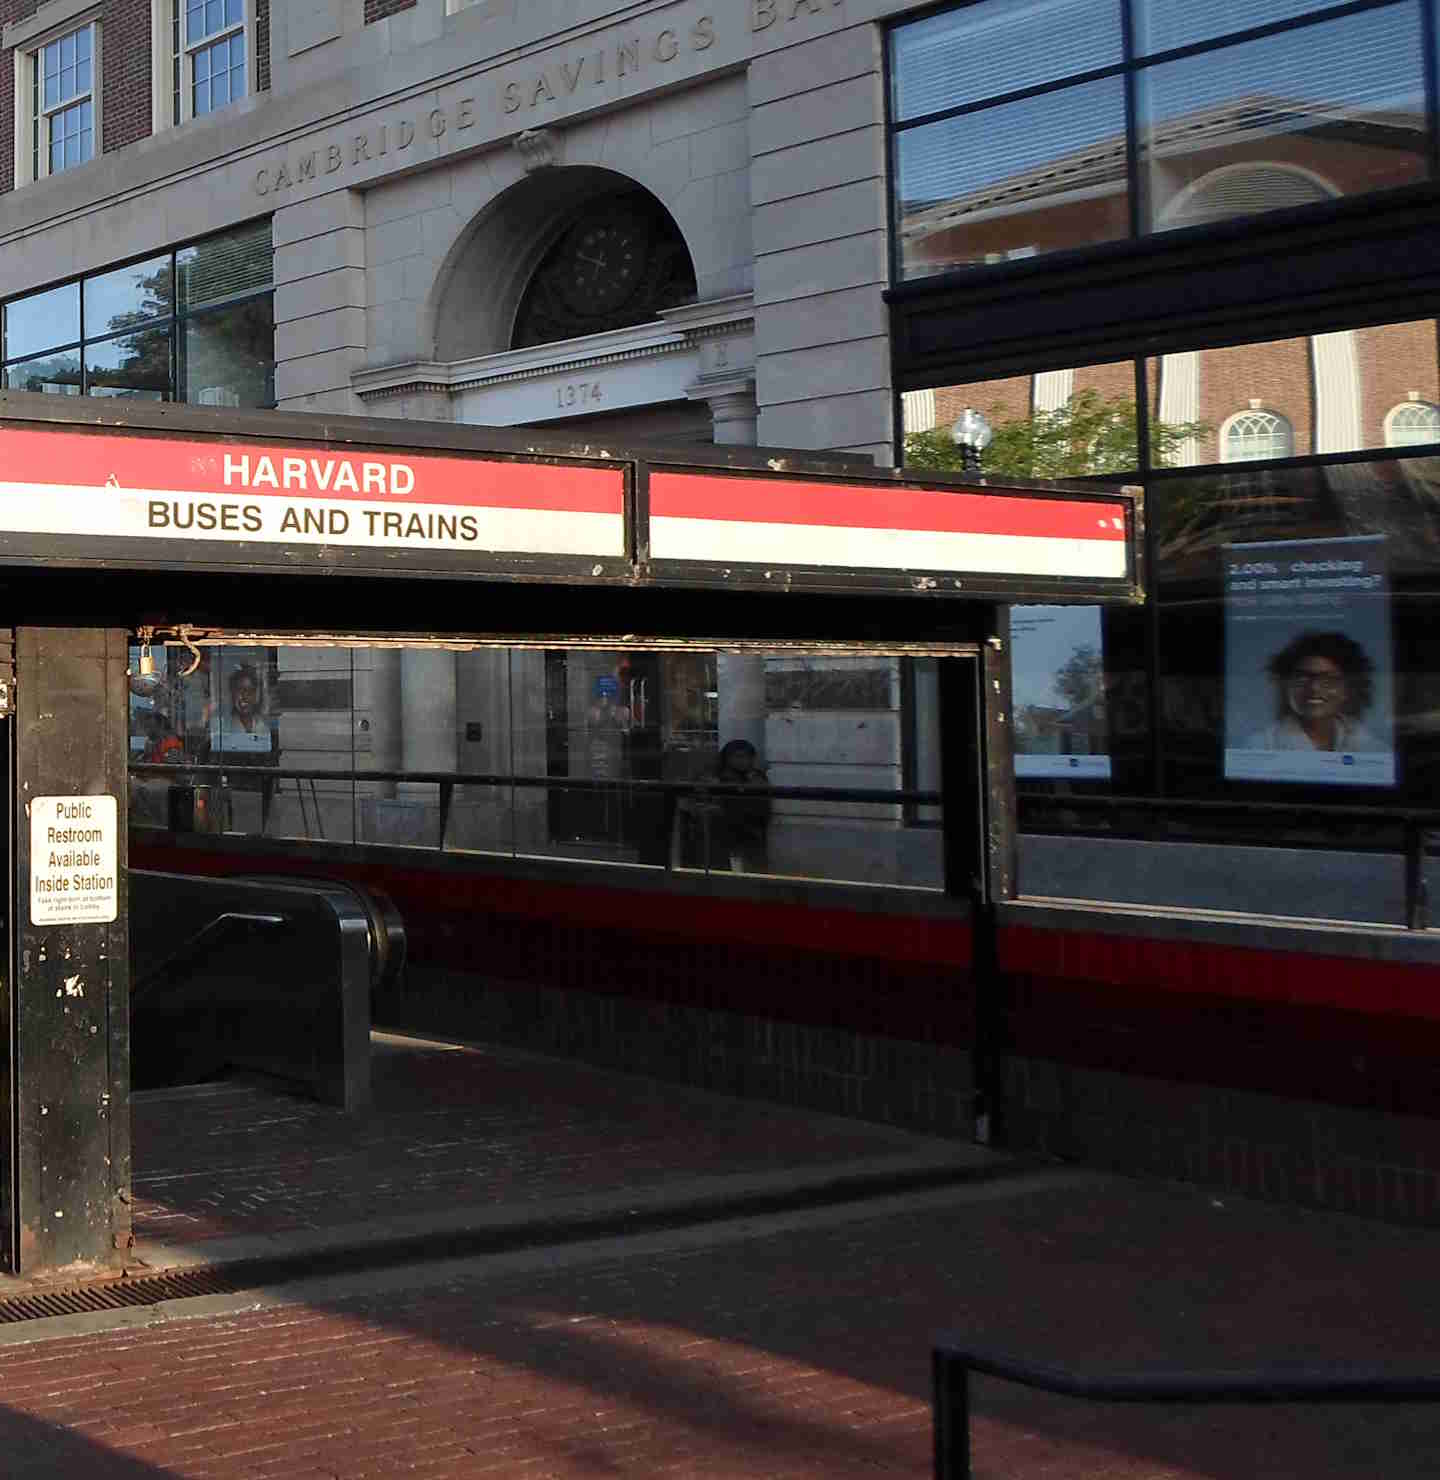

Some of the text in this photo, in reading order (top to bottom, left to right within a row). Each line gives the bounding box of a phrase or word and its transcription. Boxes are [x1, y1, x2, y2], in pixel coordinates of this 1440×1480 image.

[254, 0, 841, 197] CAMBRIDGE SAVINGS BA
[223, 453, 416, 495] HARVARD
[148, 500, 479, 541] BUSES AND TRAINS
[56, 802, 92, 820] Public
[47, 827, 103, 844] Restroom
[48, 850, 101, 868] Available
[35, 874, 114, 893] Inside Station
